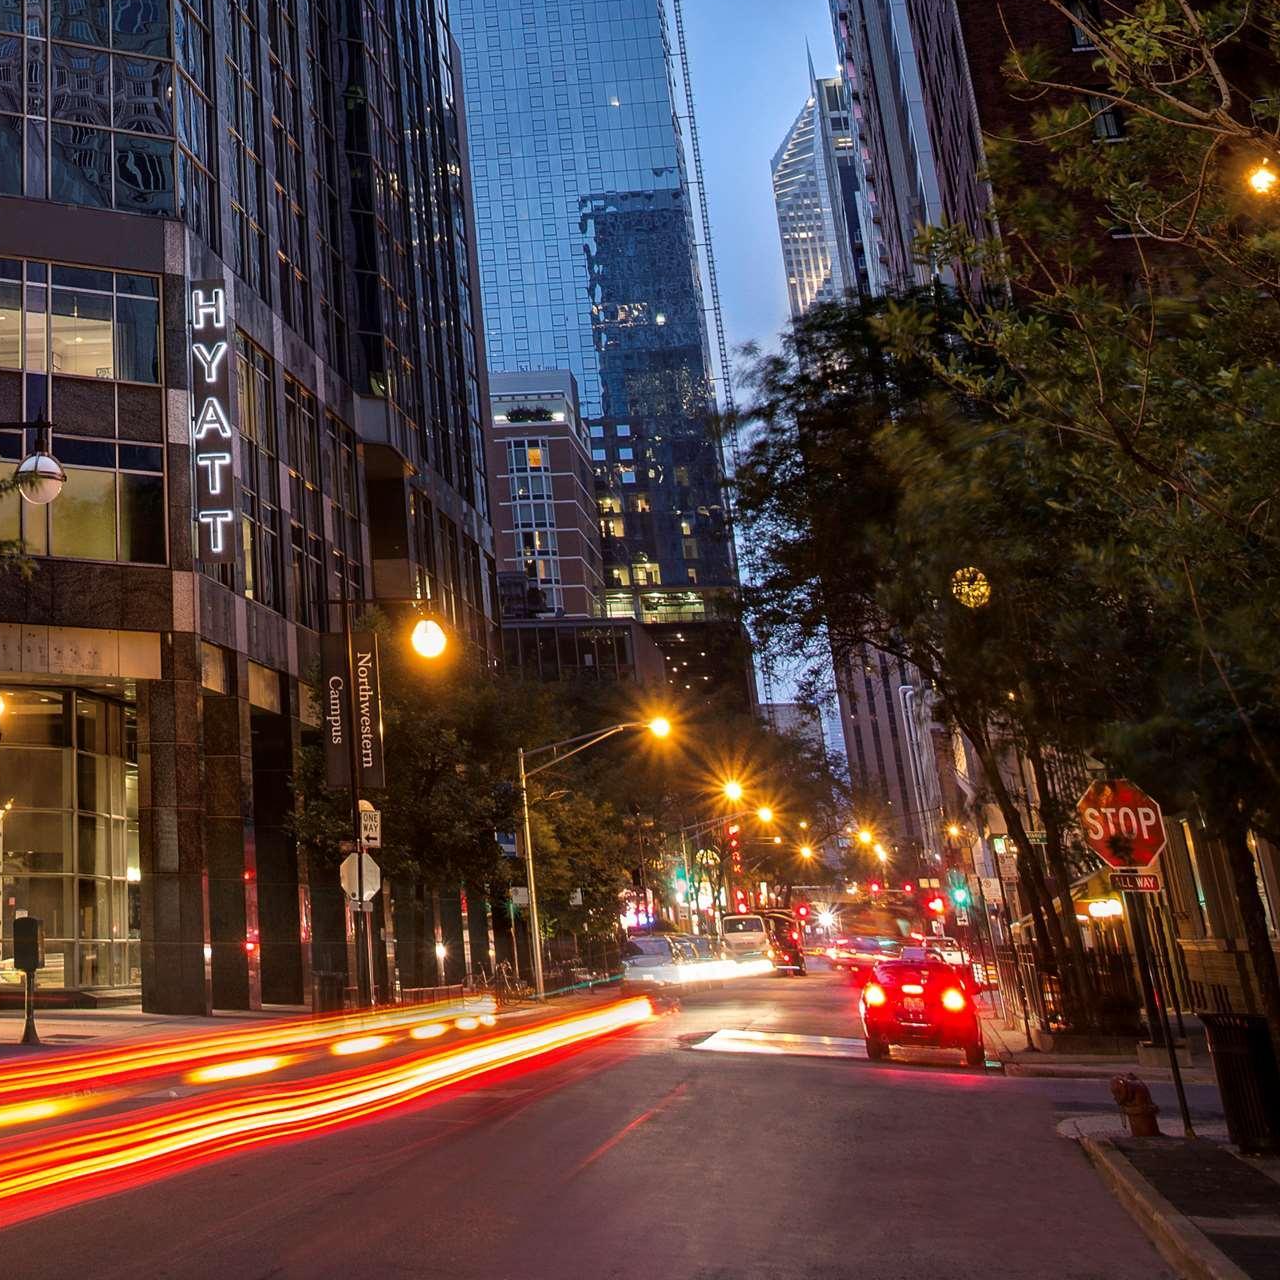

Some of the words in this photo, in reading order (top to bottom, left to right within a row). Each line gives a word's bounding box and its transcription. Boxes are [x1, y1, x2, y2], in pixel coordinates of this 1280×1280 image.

[191, 288, 233, 553] HYATT
[327, 675, 344, 745] Campus
[357, 652, 375, 769] Northwestern
[363, 812, 379, 823] ONE
[363, 823, 379, 833] WAY
[1084, 806, 1156, 840] STOP
[1114, 876, 1134, 888] LL
[1135, 876, 1155, 889] WAY
